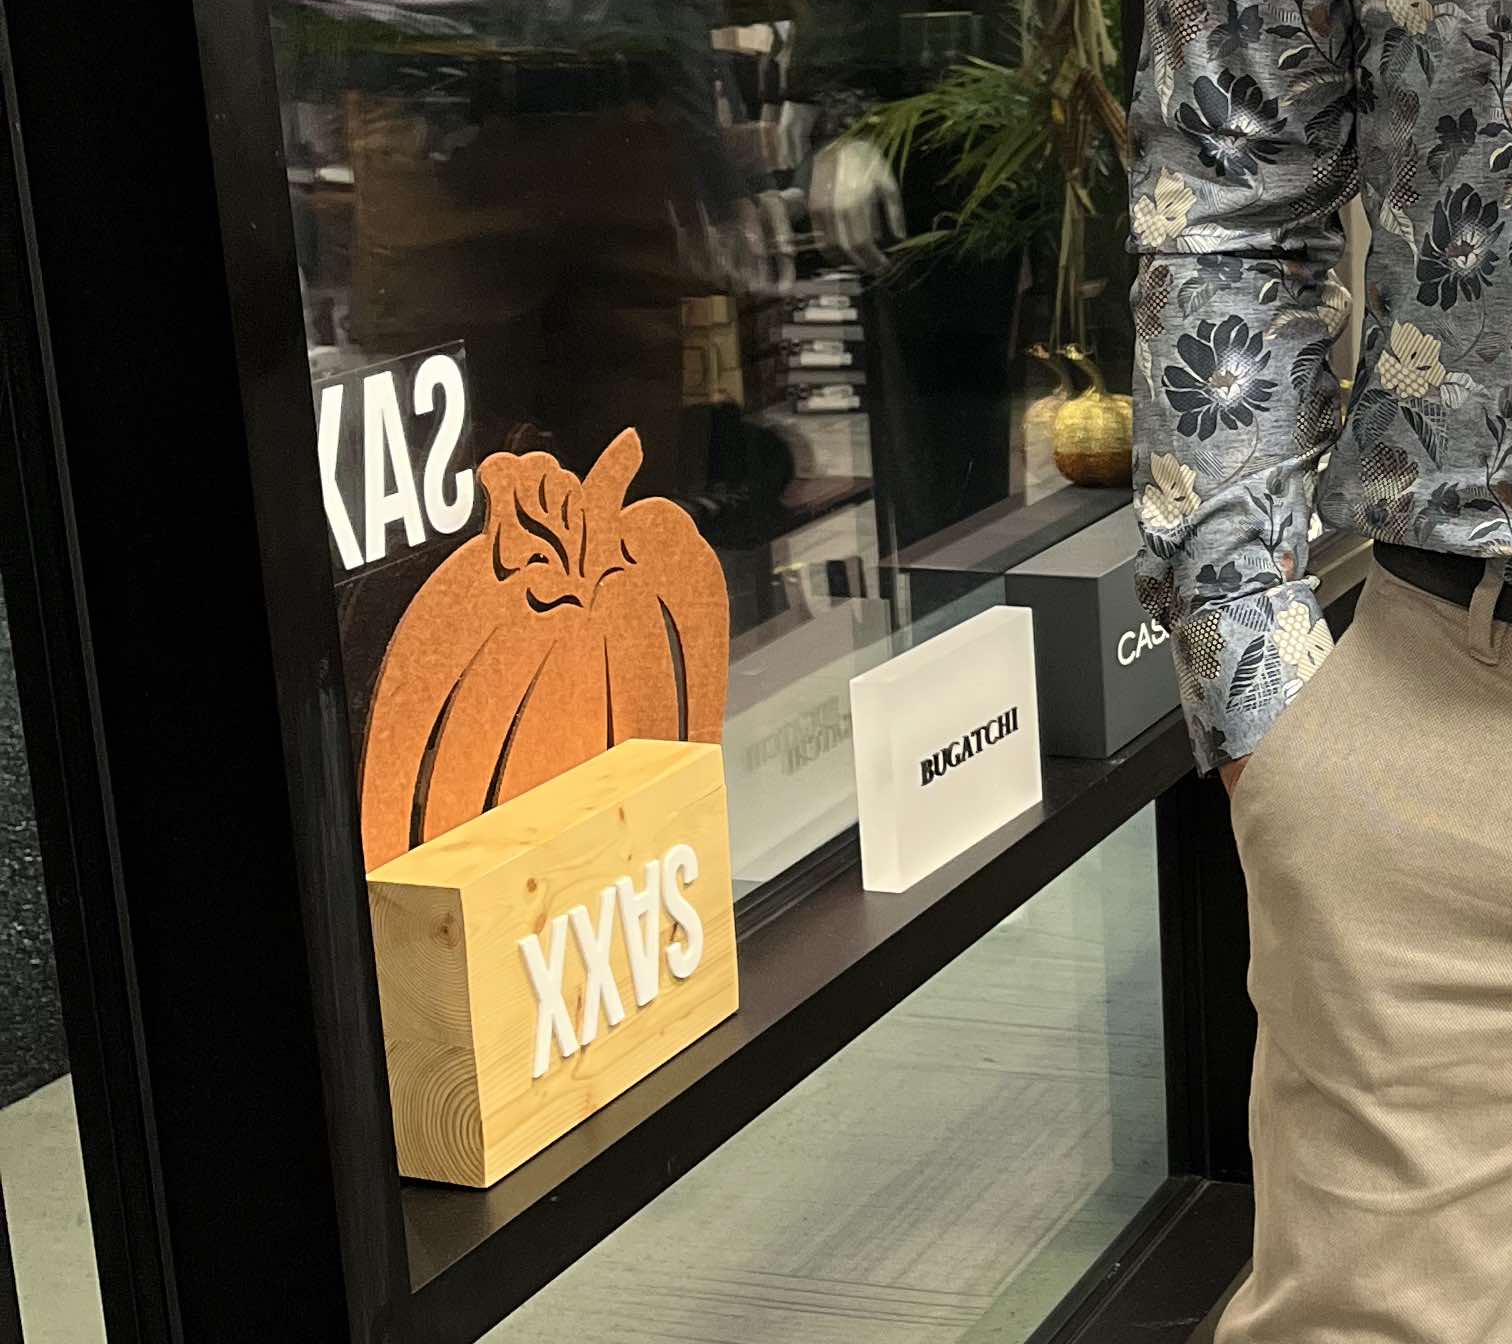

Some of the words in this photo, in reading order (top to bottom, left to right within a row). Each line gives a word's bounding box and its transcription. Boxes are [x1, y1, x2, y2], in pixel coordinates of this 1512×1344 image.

[1117, 618, 1170, 666] CAS
[920, 706, 1019, 787] BUGATCHI
[517, 843, 704, 1079] SAXX
